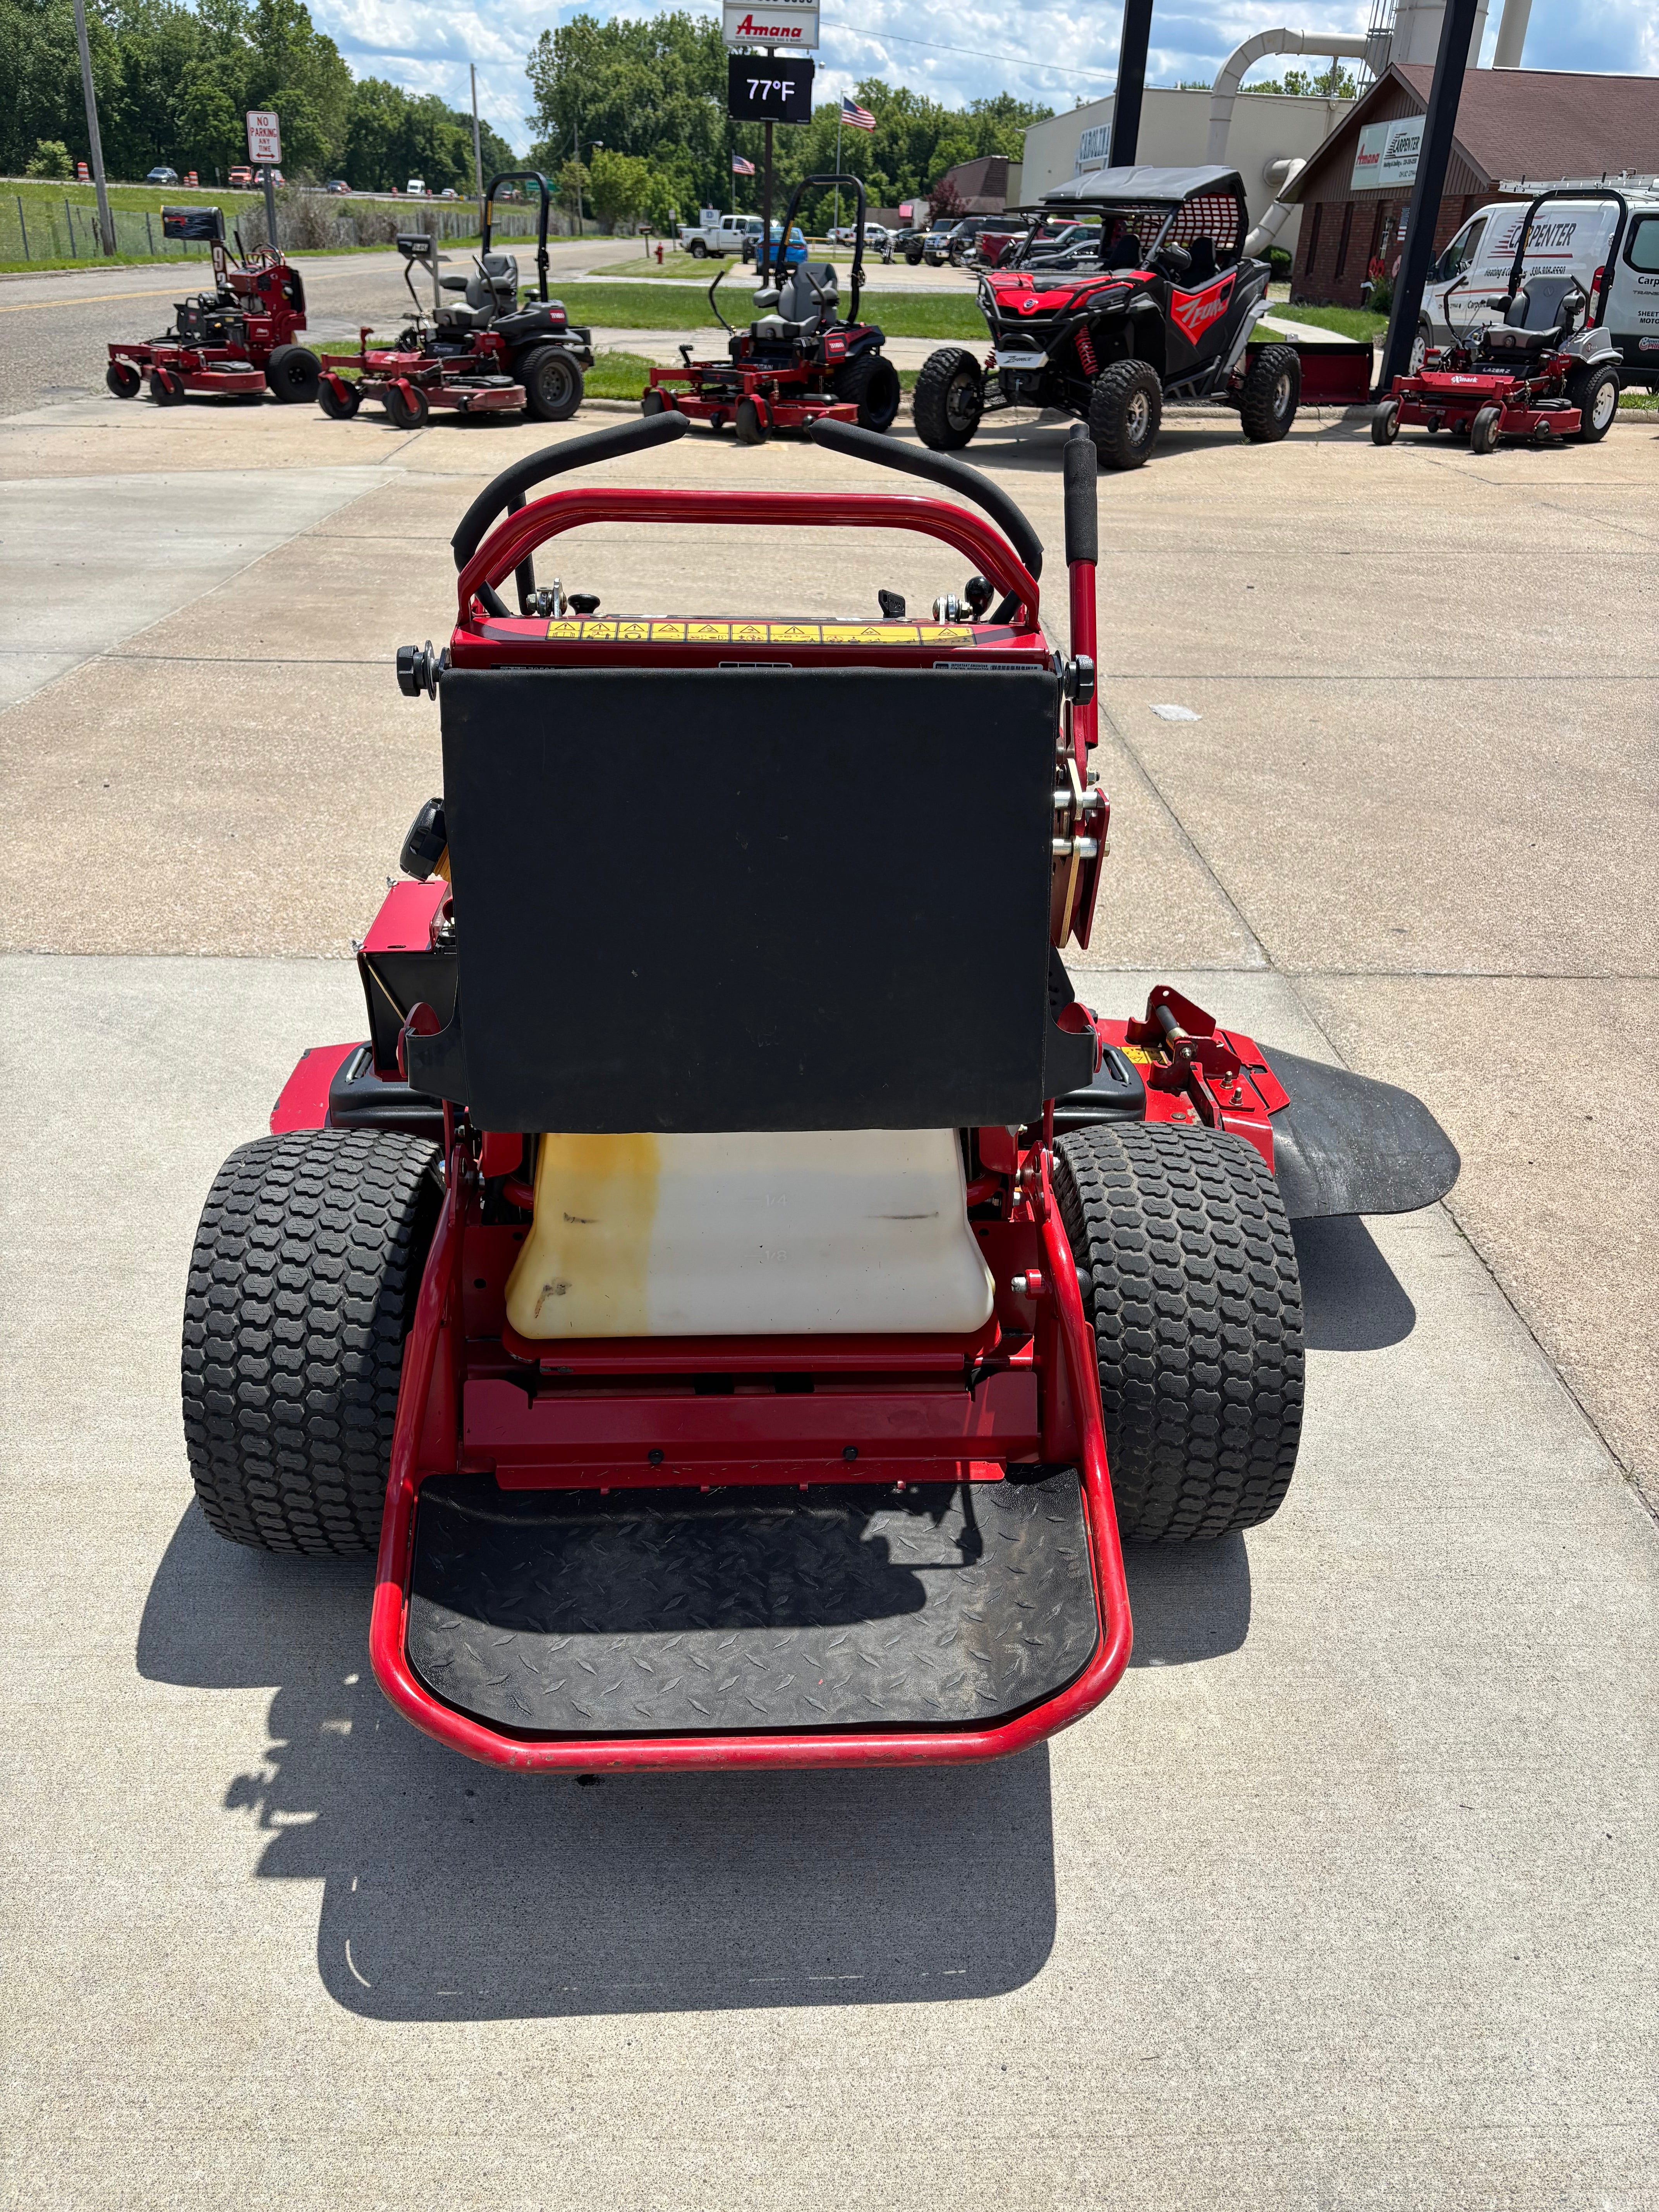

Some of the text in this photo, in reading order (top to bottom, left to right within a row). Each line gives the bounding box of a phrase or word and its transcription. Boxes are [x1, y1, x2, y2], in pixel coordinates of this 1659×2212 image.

[736, 14, 803, 38] Amana
[747, 79, 795, 101] 77°F
[257, 117, 269, 126] NO
[250, 127, 277, 137] PARKING
[1393, 136, 1420, 153] CARPENTER
[1356, 143, 1380, 166] Amana
[1509, 223, 1577, 248] CPENTER
[766, 1194, 787, 1206] 1/4
[765, 1250, 787, 1261] 1/8
